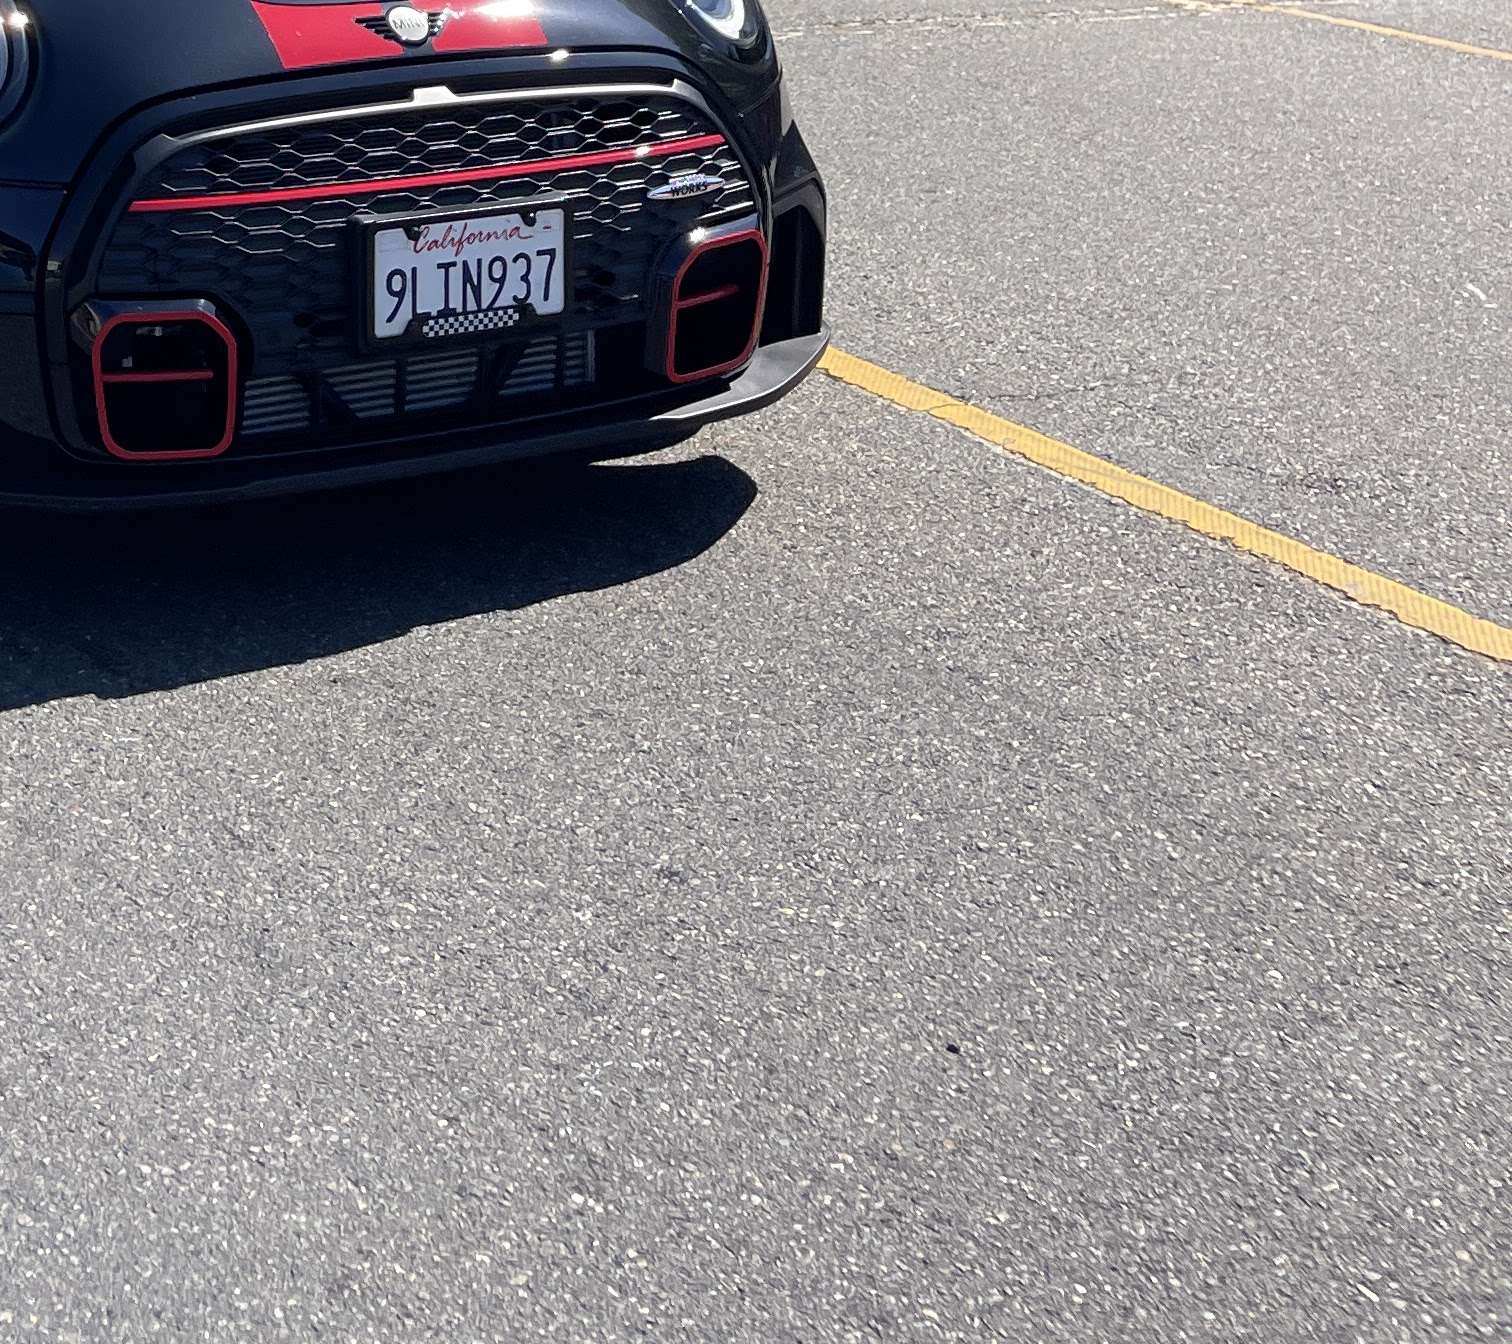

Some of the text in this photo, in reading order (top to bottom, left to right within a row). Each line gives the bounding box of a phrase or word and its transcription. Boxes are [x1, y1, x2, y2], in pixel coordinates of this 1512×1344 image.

[391, 17, 426, 30] MINI
[670, 180, 708, 197] WORKS
[412, 222, 535, 257] California
[385, 247, 557, 324] 9LIN937
